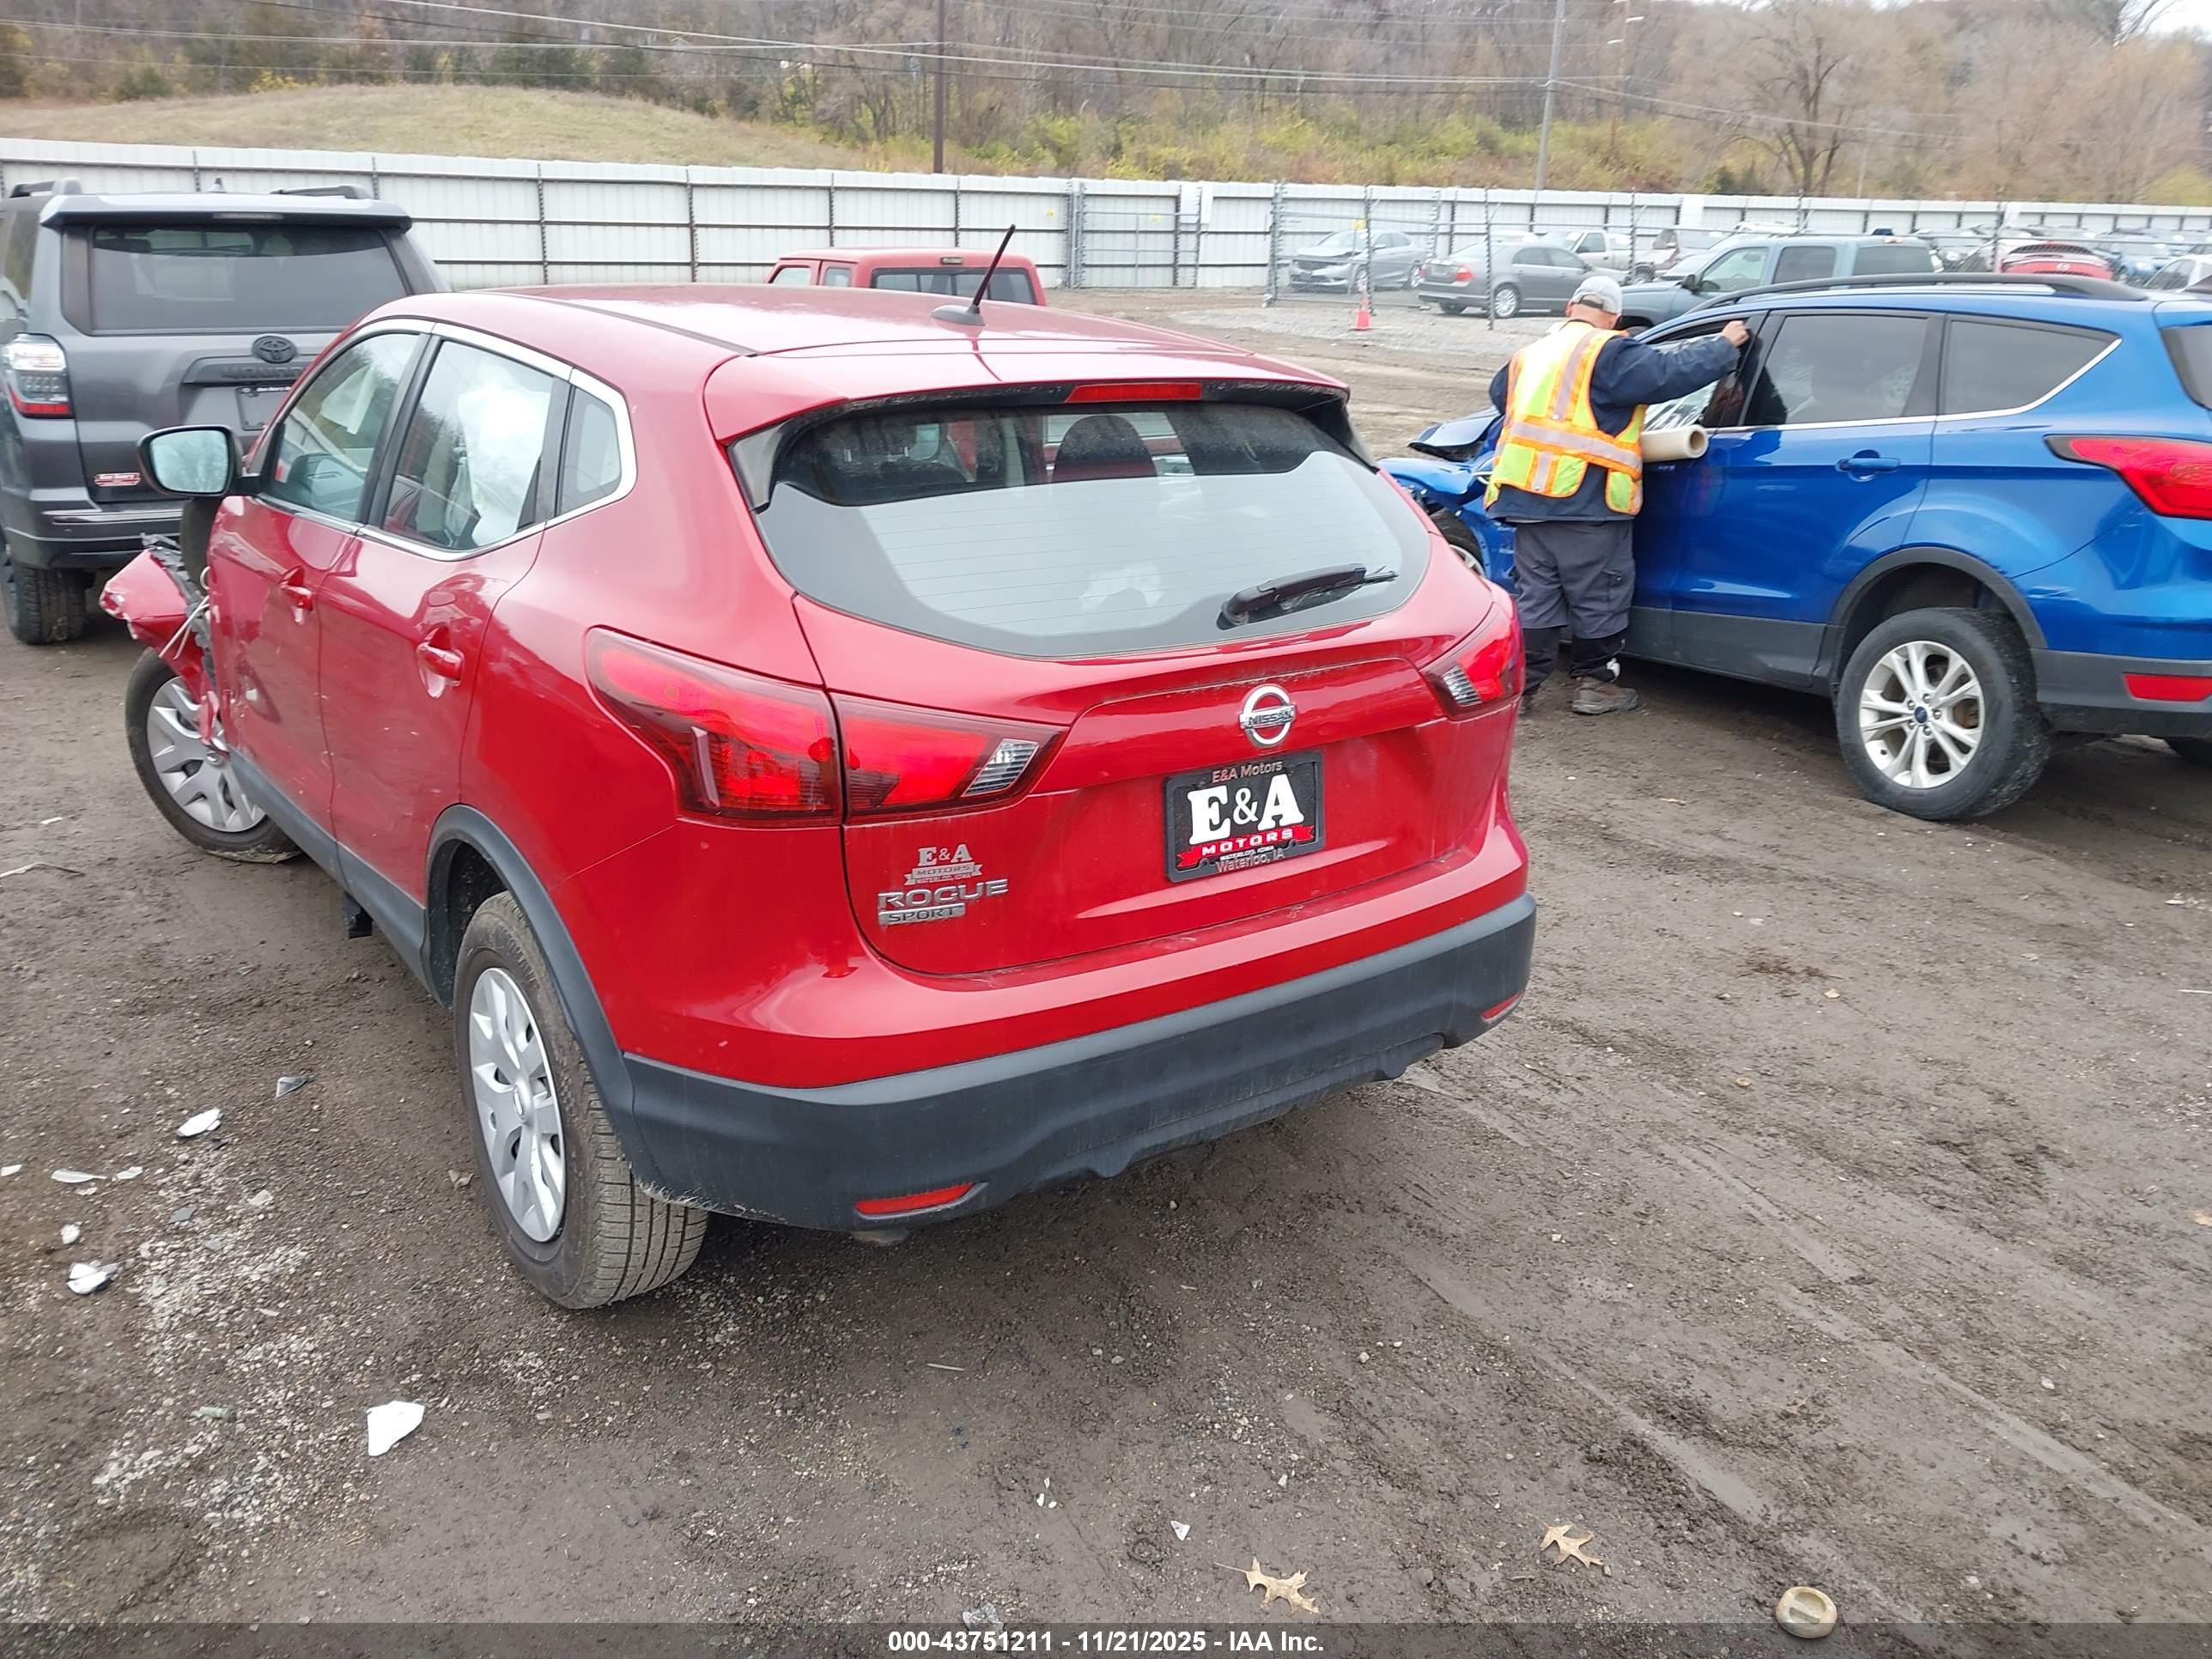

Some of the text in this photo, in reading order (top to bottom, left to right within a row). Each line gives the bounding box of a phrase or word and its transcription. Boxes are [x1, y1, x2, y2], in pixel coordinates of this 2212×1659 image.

[1249, 709, 1292, 725] NISSAN
[1212, 762, 1283, 784] E&A Motors
[1188, 774, 1304, 845] E&A
[1202, 829, 1293, 856] MOTORS
[917, 843, 972, 866] E&A
[1215, 848, 1285, 873] Waterloo, IA
[916, 865, 971, 876] MOTORS
[878, 878, 1009, 908] ROGUE
[889, 906, 958, 923] SPORT
